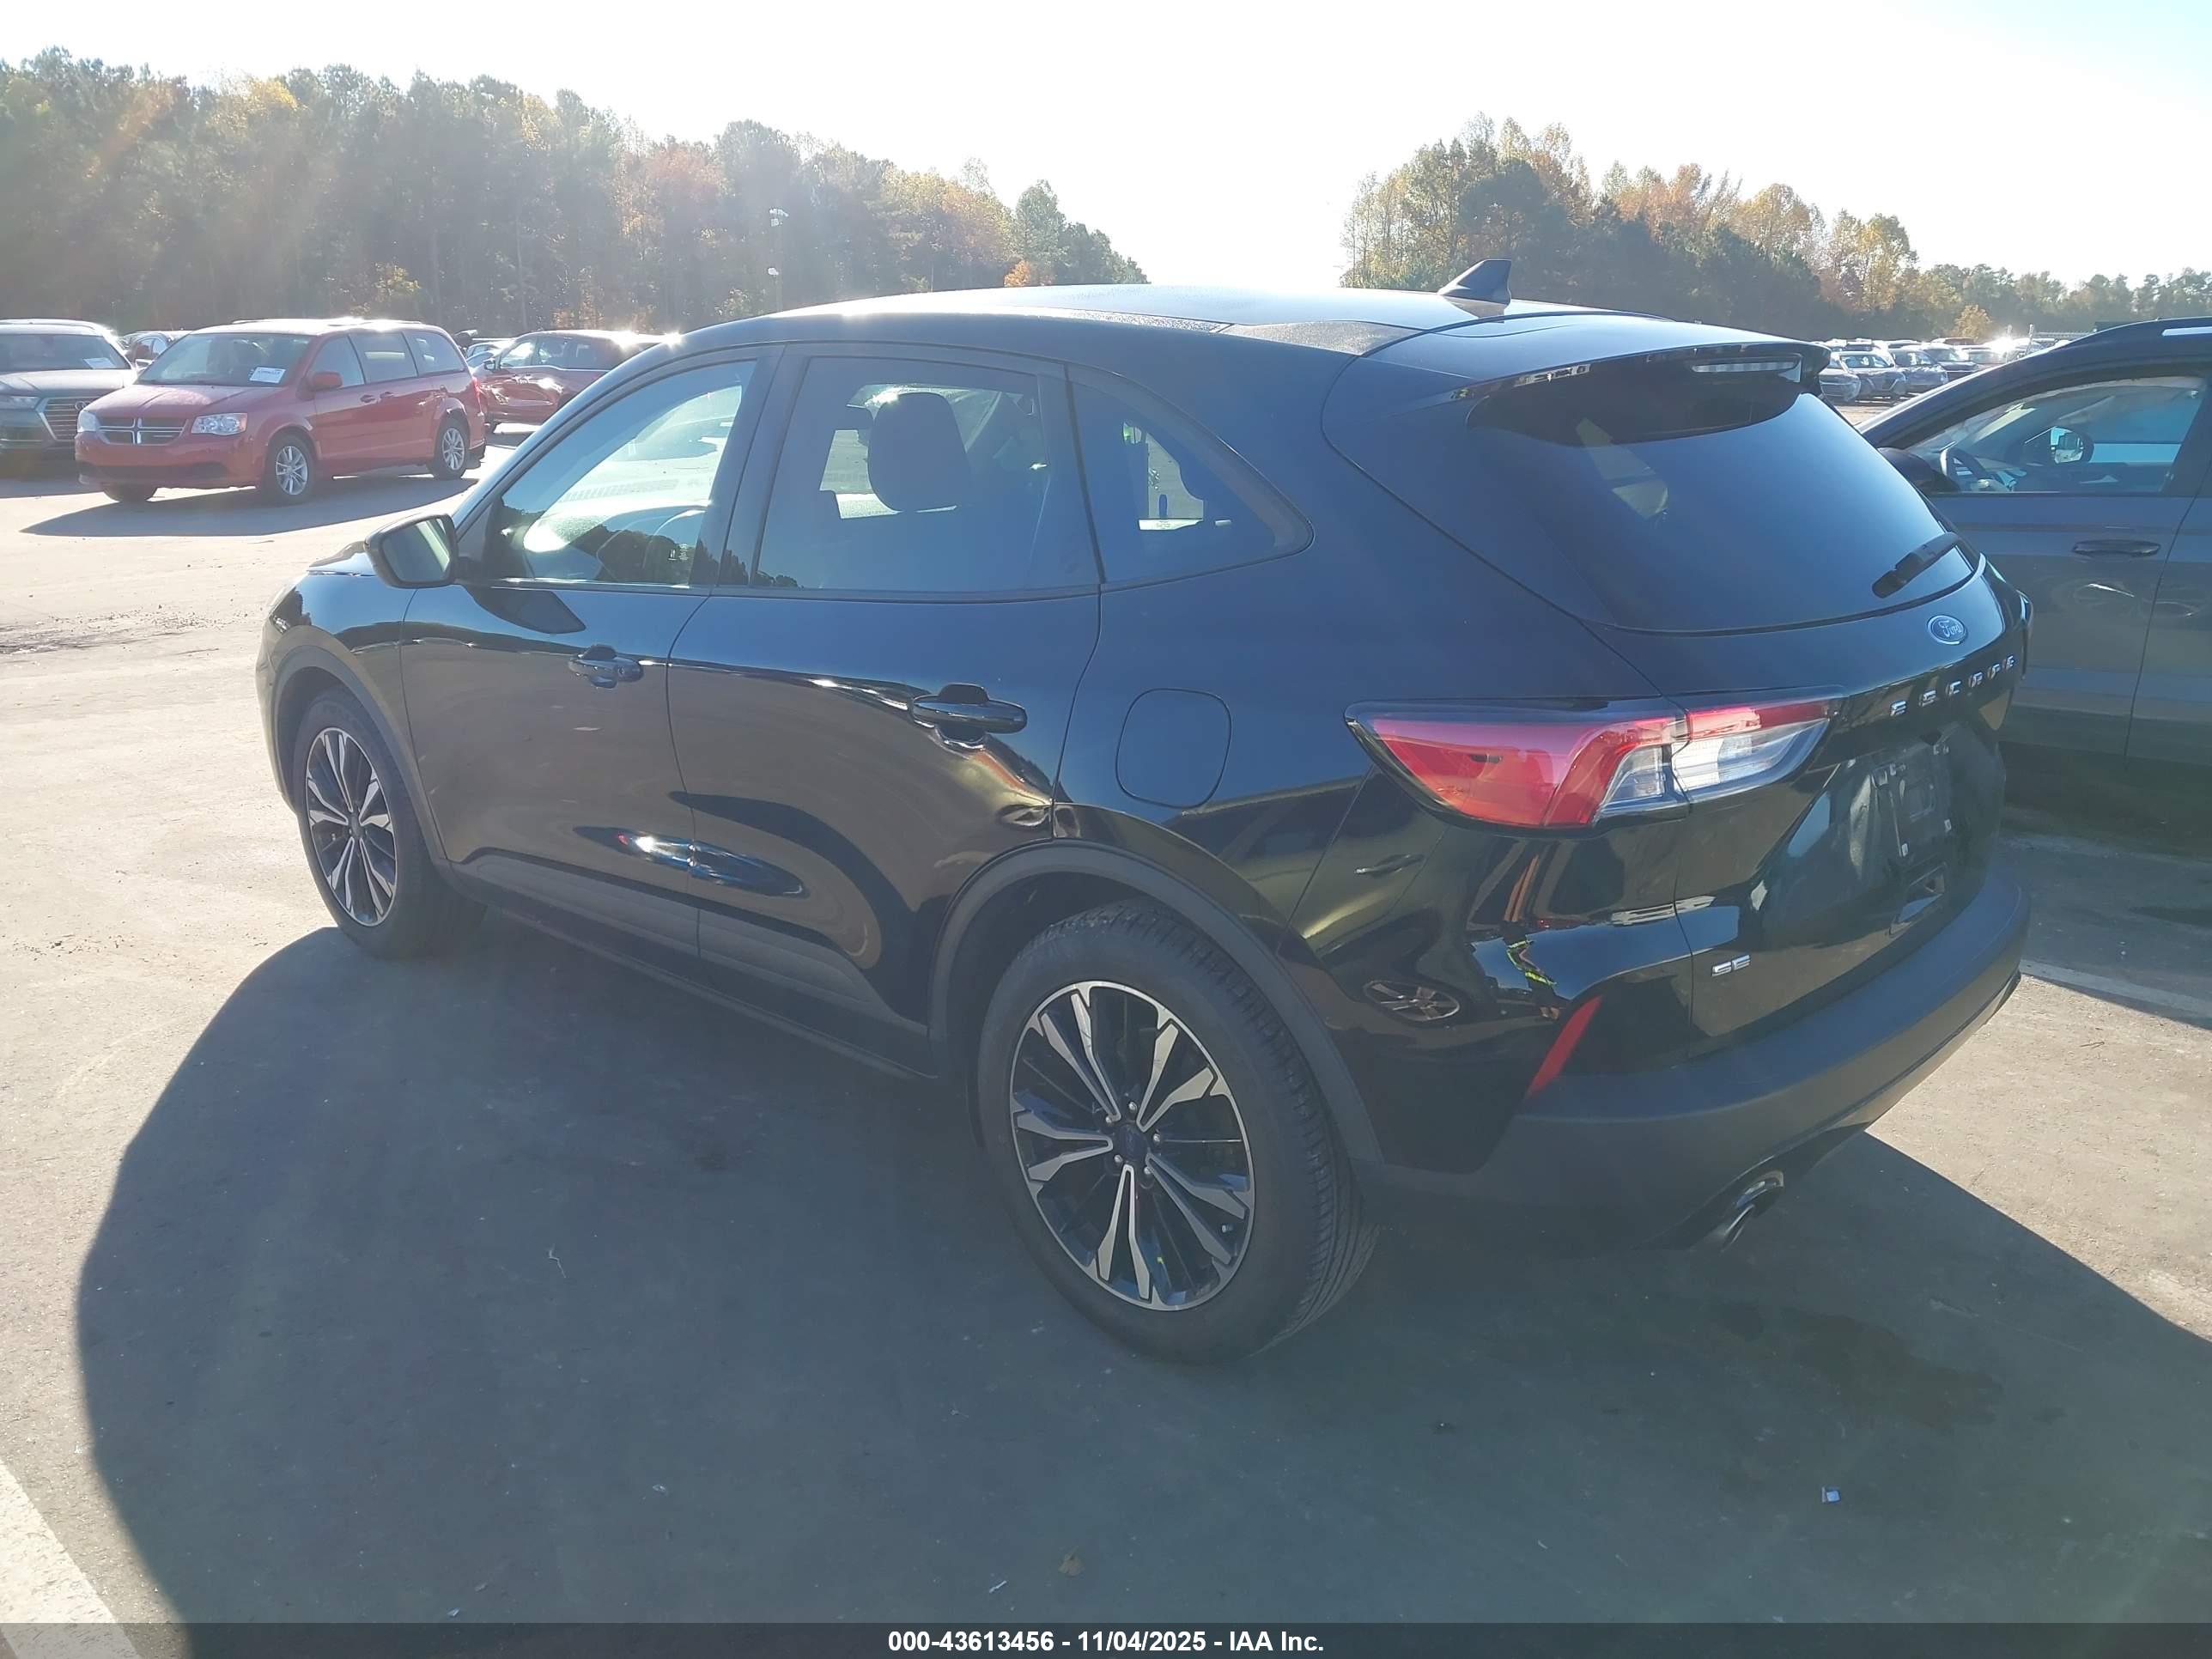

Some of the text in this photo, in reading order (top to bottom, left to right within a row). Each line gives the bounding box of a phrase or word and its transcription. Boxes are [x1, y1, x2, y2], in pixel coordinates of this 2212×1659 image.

[1937, 619, 1965, 638] Ford
[1889, 654, 2016, 717] ESCAPE
[1711, 954, 1751, 977] SE
